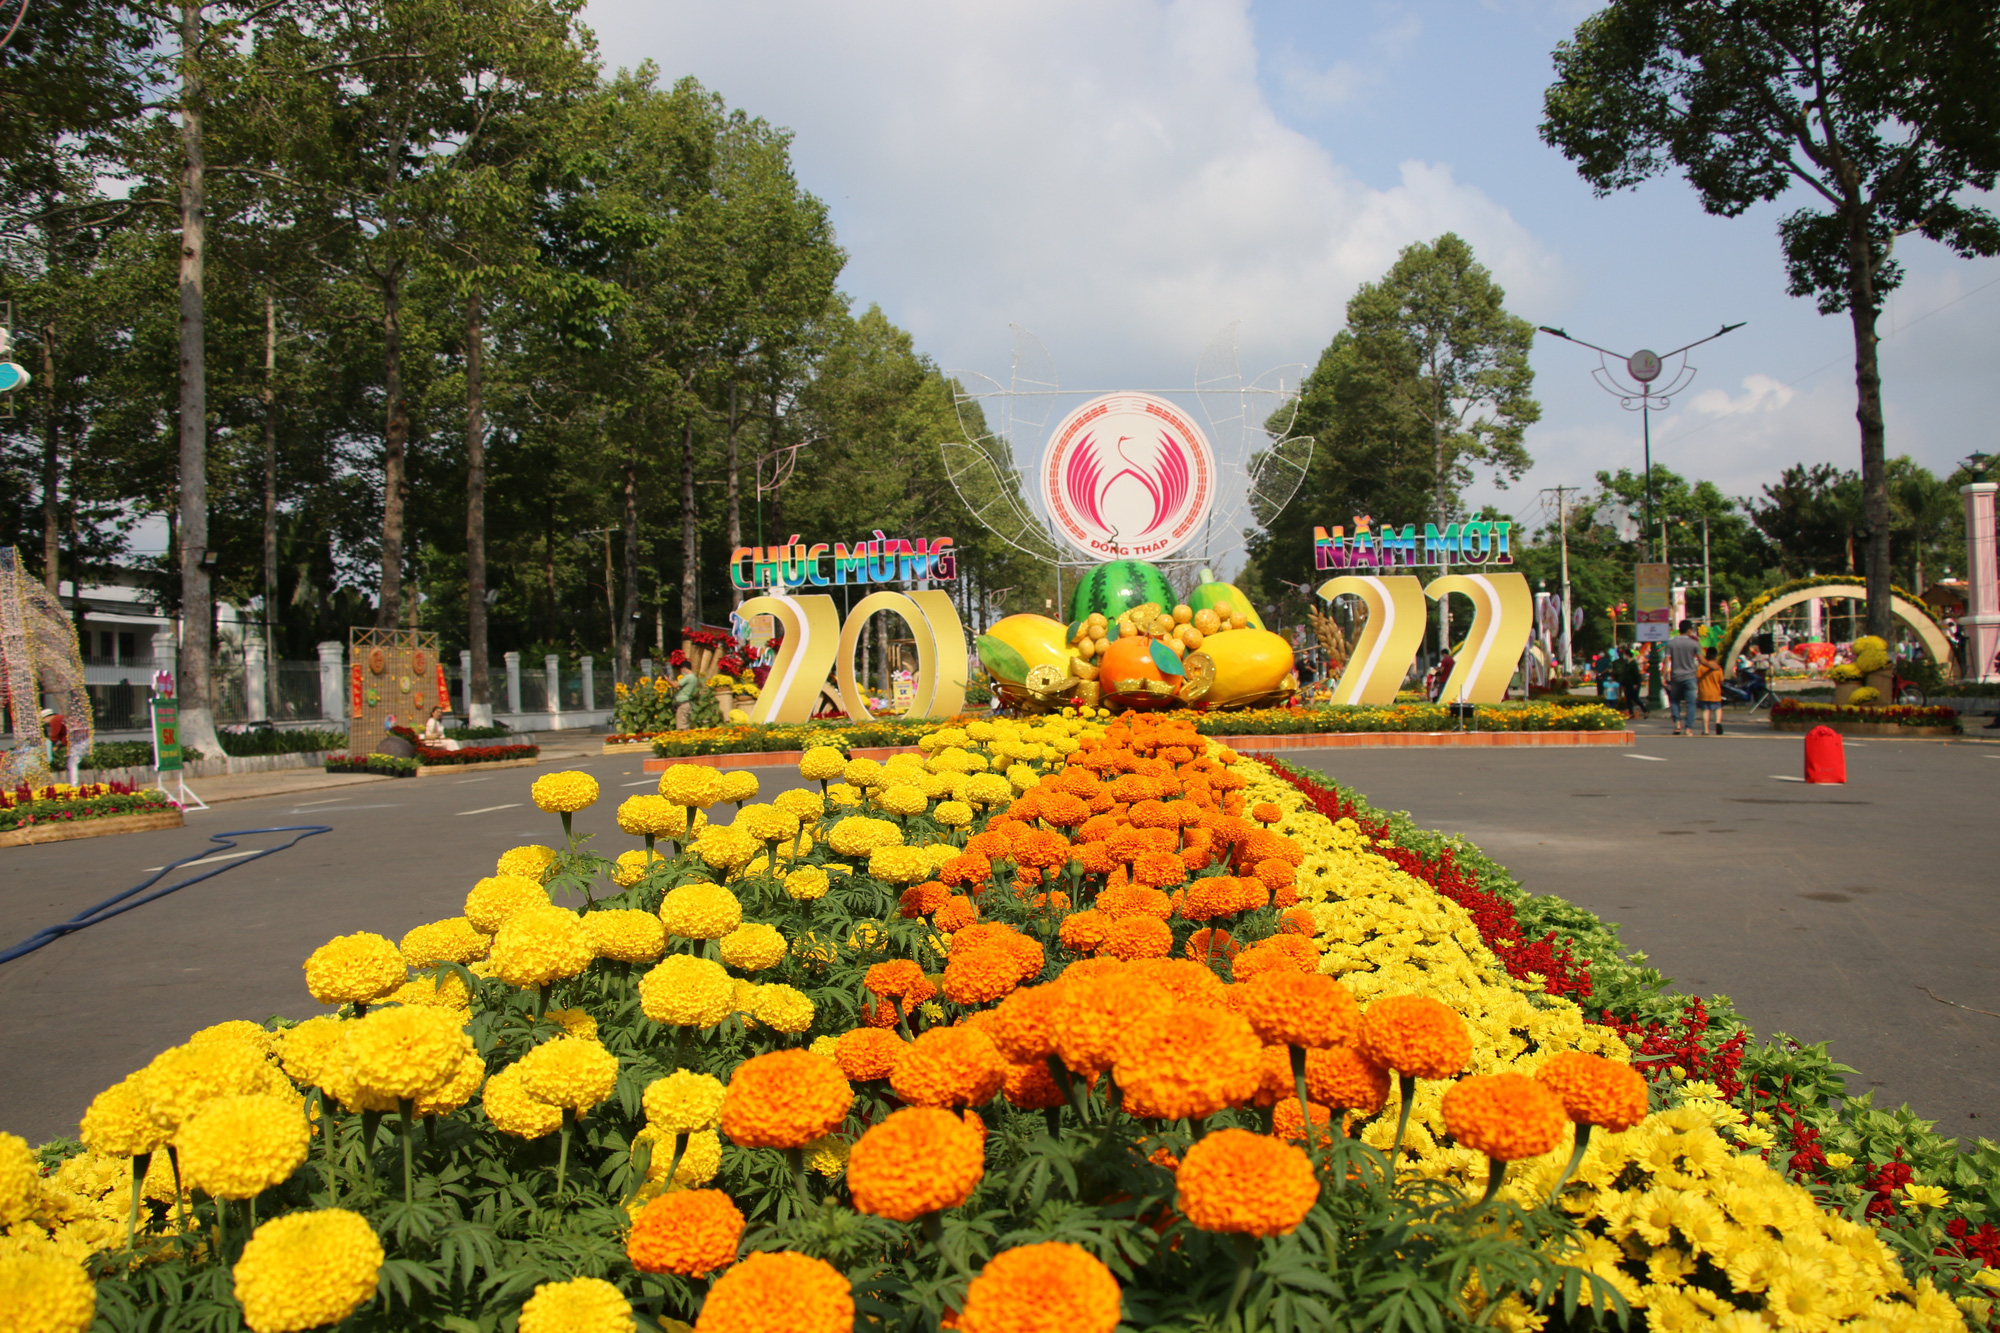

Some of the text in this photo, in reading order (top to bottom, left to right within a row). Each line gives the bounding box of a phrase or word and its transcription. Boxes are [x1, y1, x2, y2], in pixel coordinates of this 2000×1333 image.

[730, 529, 956, 590] CHÚC MỪNG
[1133, 539, 1168, 555] THÁP
[1314, 512, 1513, 570] NĂM MỚI
[736, 589, 968, 724] 20
[1316, 572, 1534, 706] 22
